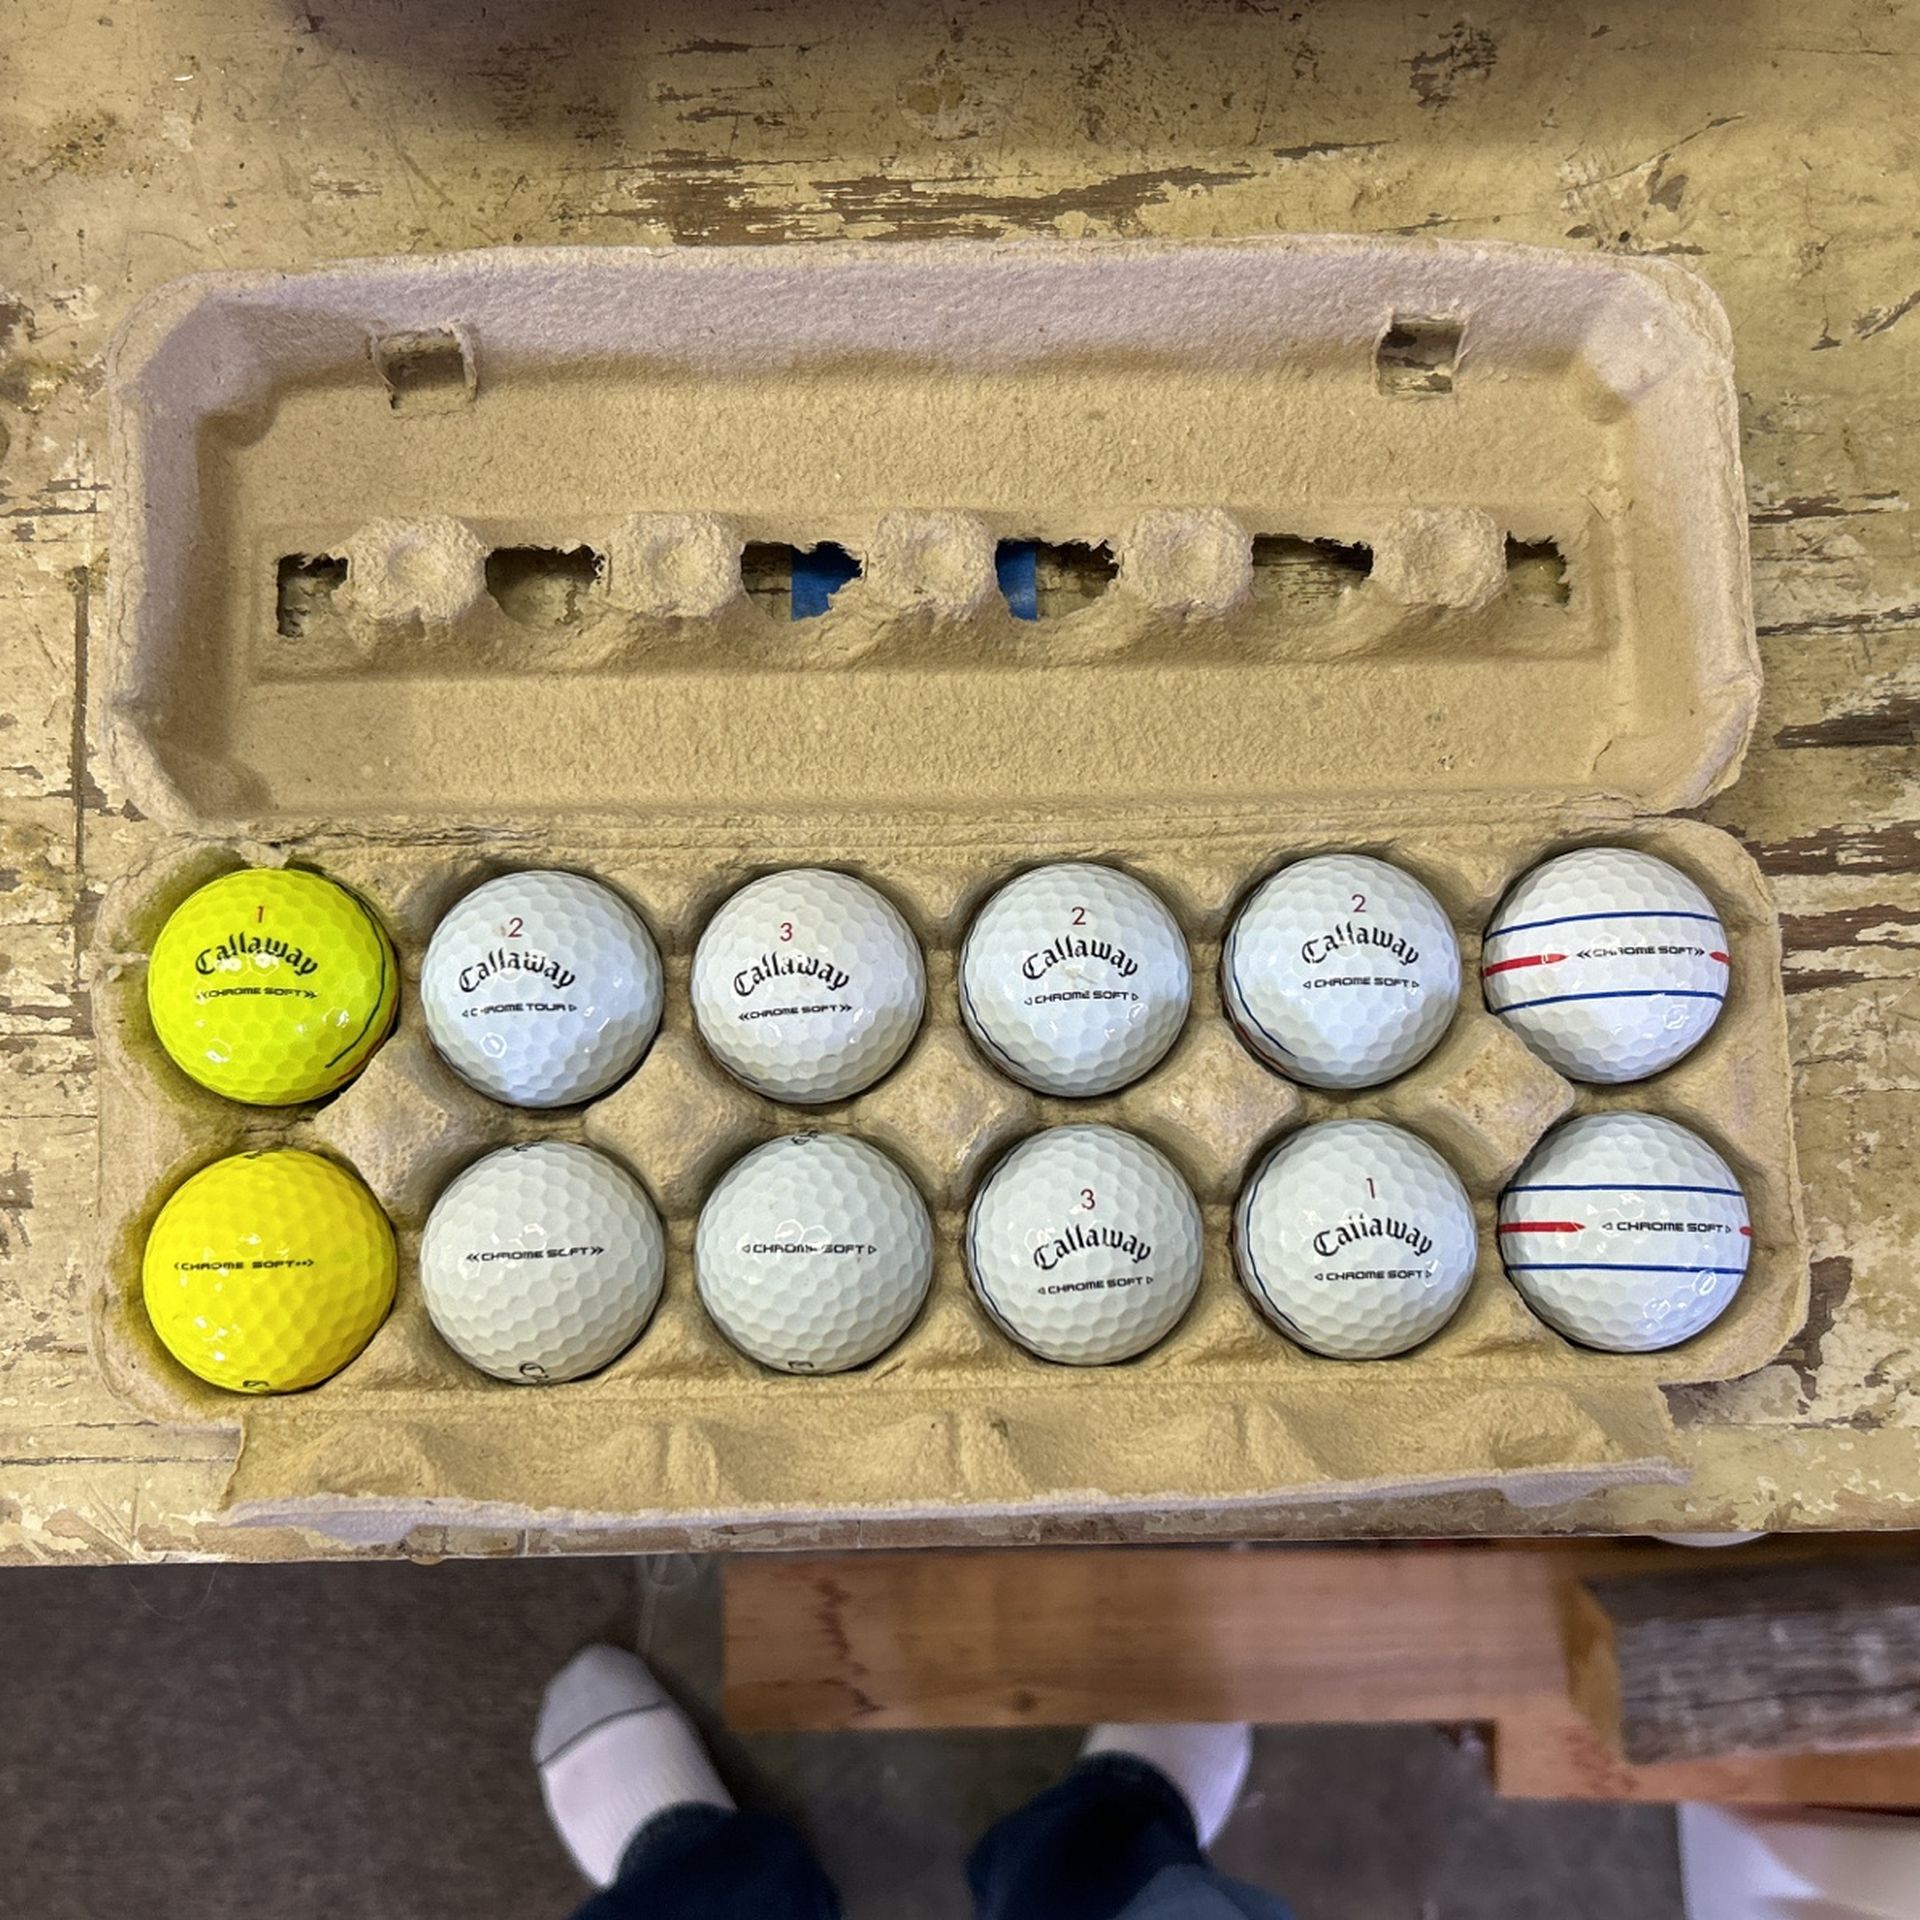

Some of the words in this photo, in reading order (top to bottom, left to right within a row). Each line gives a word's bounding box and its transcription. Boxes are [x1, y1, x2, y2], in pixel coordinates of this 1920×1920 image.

[1351, 894, 1367, 913] 2
[256, 905, 264, 924] 1
[1071, 906, 1087, 926] 2
[507, 917, 524, 938] 2
[779, 922, 793, 942] 3
[1301, 921, 1420, 966] Callaway
[1592, 946, 1656, 958] CHROME
[1657, 945, 1692, 956] SOFT
[195, 931, 318, 976] Callaway
[1022, 934, 1138, 980] Callaway
[459, 947, 576, 993] Callaway
[734, 951, 850, 997] Callaway
[1313, 976, 1371, 988] CHROME
[1373, 977, 1410, 988] SOFT
[208, 987, 262, 998] CHROME
[264, 987, 301, 997] SOFT
[1034, 990, 1091, 1004] CHROME
[1092, 990, 1129, 1001] SOFT
[470, 1002, 524, 1017] CHROME
[525, 1002, 567, 1012] TOUR
[749, 1006, 799, 1019] CHROME
[801, 1004, 838, 1015] SOFT
[1365, 1177, 1376, 1200] 1
[1080, 1188, 1096, 1210] 3
[1313, 1211, 1433, 1257] Callaway
[1616, 1221, 1684, 1232] CHROME
[1686, 1222, 1723, 1233] SOFT
[481, 1250, 544, 1262] CHROME
[546, 1246, 589, 1258] SOFT
[821, 1243, 865, 1255] SOFT
[1033, 1223, 1152, 1271] Callaway
[180, 1262, 245, 1271] CHROME
[251, 1259, 295, 1269] SOFT
[1325, 1270, 1385, 1281] CHROME
[1386, 1269, 1423, 1280] SOFT
[1047, 1280, 1105, 1295] CHROME
[1106, 1276, 1144, 1288] SOFT
